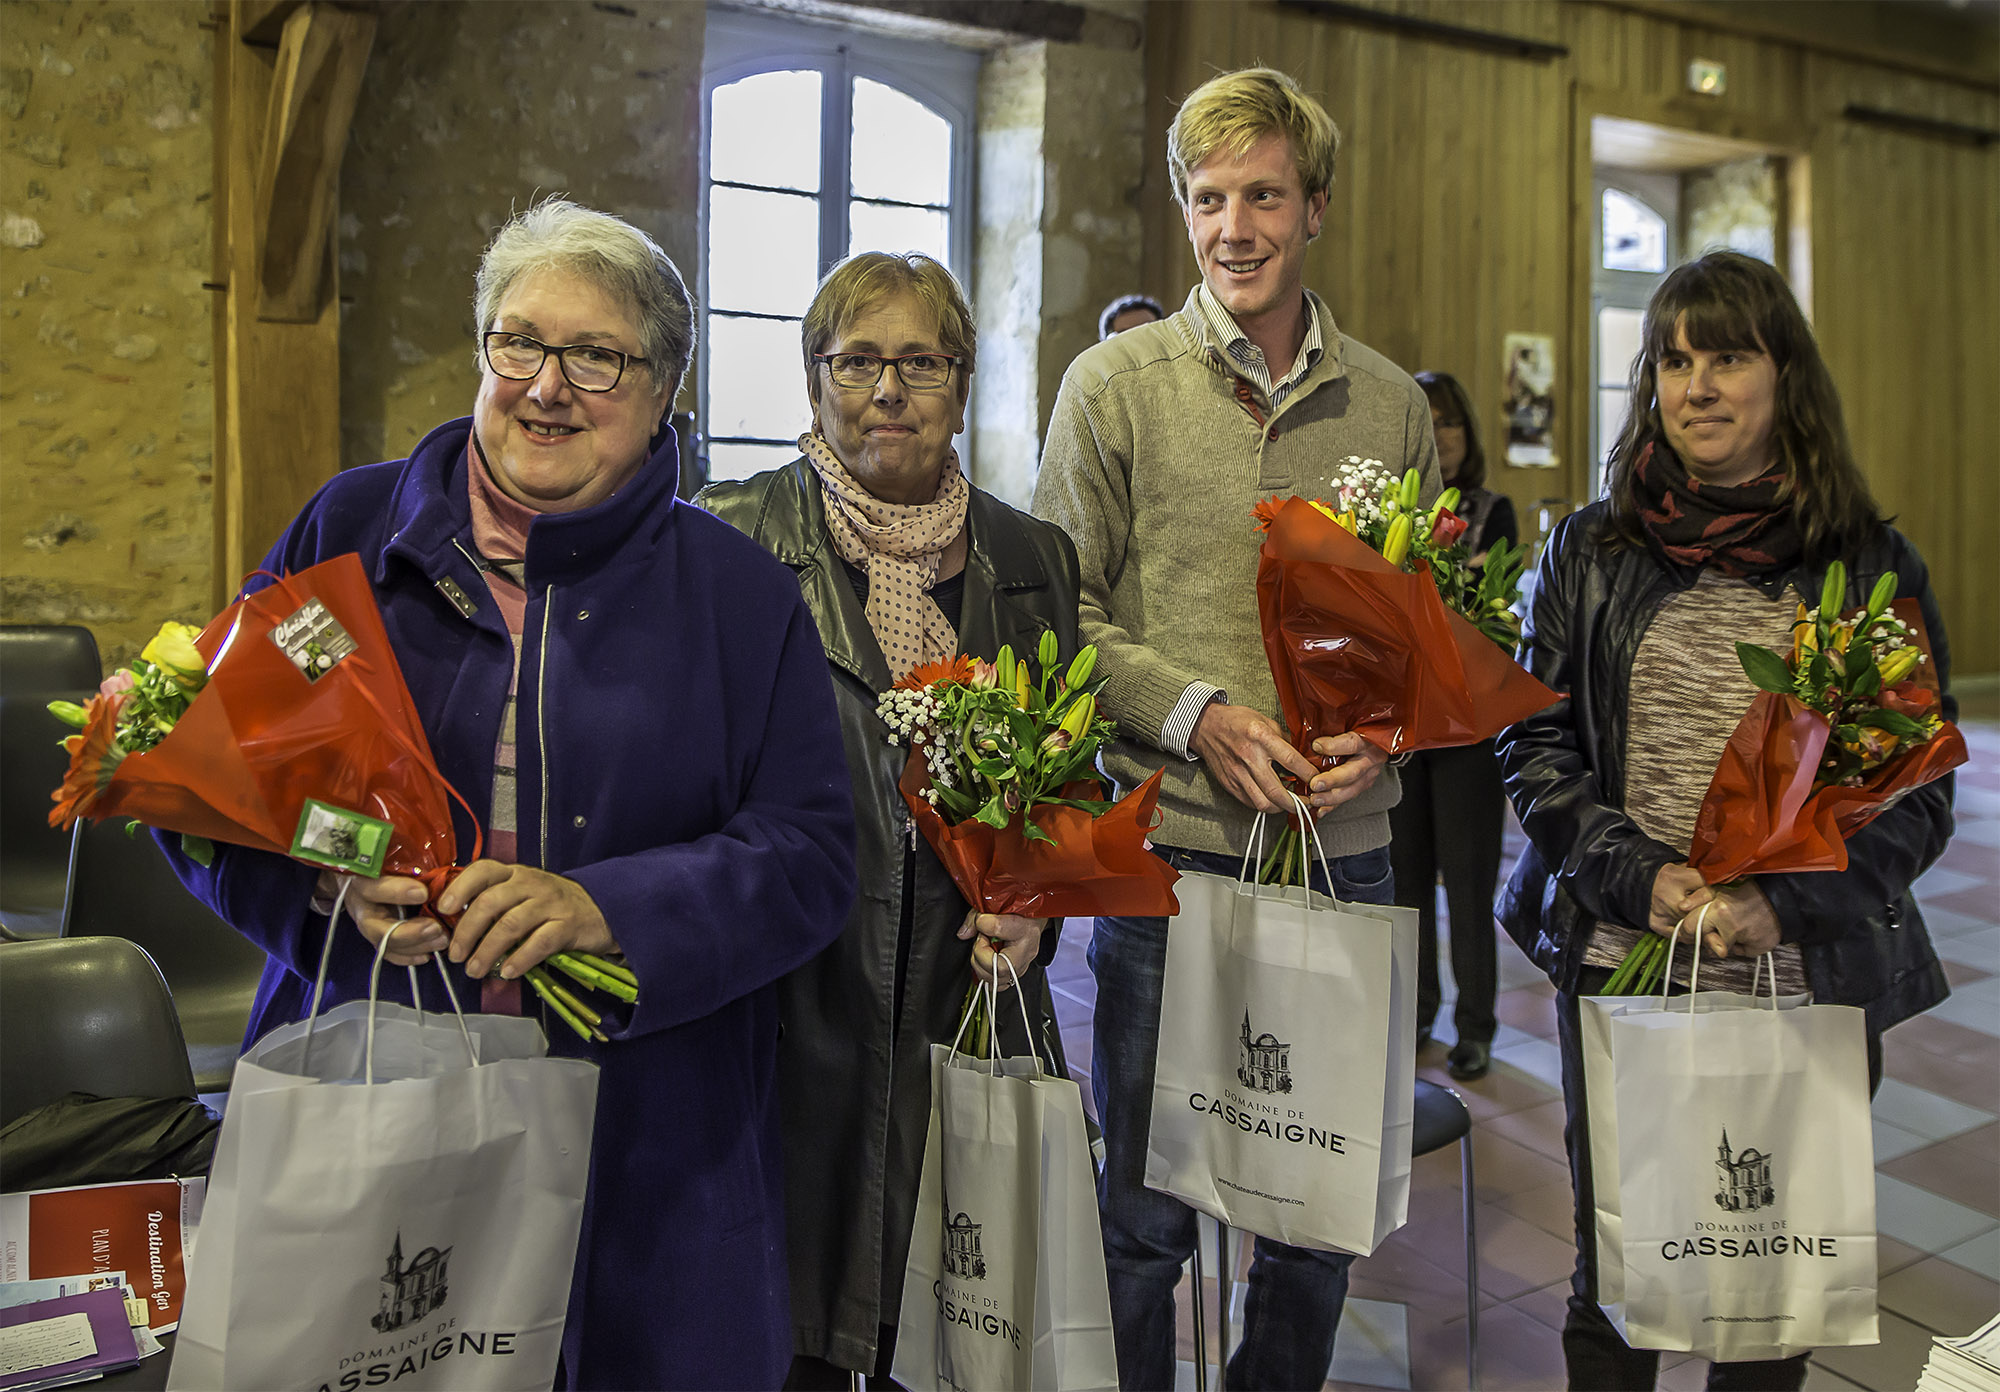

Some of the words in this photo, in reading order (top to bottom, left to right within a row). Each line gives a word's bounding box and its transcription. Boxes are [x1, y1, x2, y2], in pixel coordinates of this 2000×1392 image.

[1224, 1088, 1279, 1115] DOMAINE
[1287, 1109, 1305, 1120] DE
[1189, 1092, 1346, 1155] CASSAIGNE
[1217, 1177, 1305, 1207] www.chateaudecassaigne.com
[92, 1228, 110, 1252] PLAN
[1694, 1221, 1765, 1233] DOMAINE
[1772, 1219, 1788, 1231] DE
[148, 1211, 165, 1291] Destination
[1661, 1235, 1838, 1261] CASSAIGNE
[151, 1290, 171, 1310] Gers
[983, 1297, 999, 1310] DE
[338, 1331, 429, 1370] DOMAINE
[437, 1317, 456, 1334] DE
